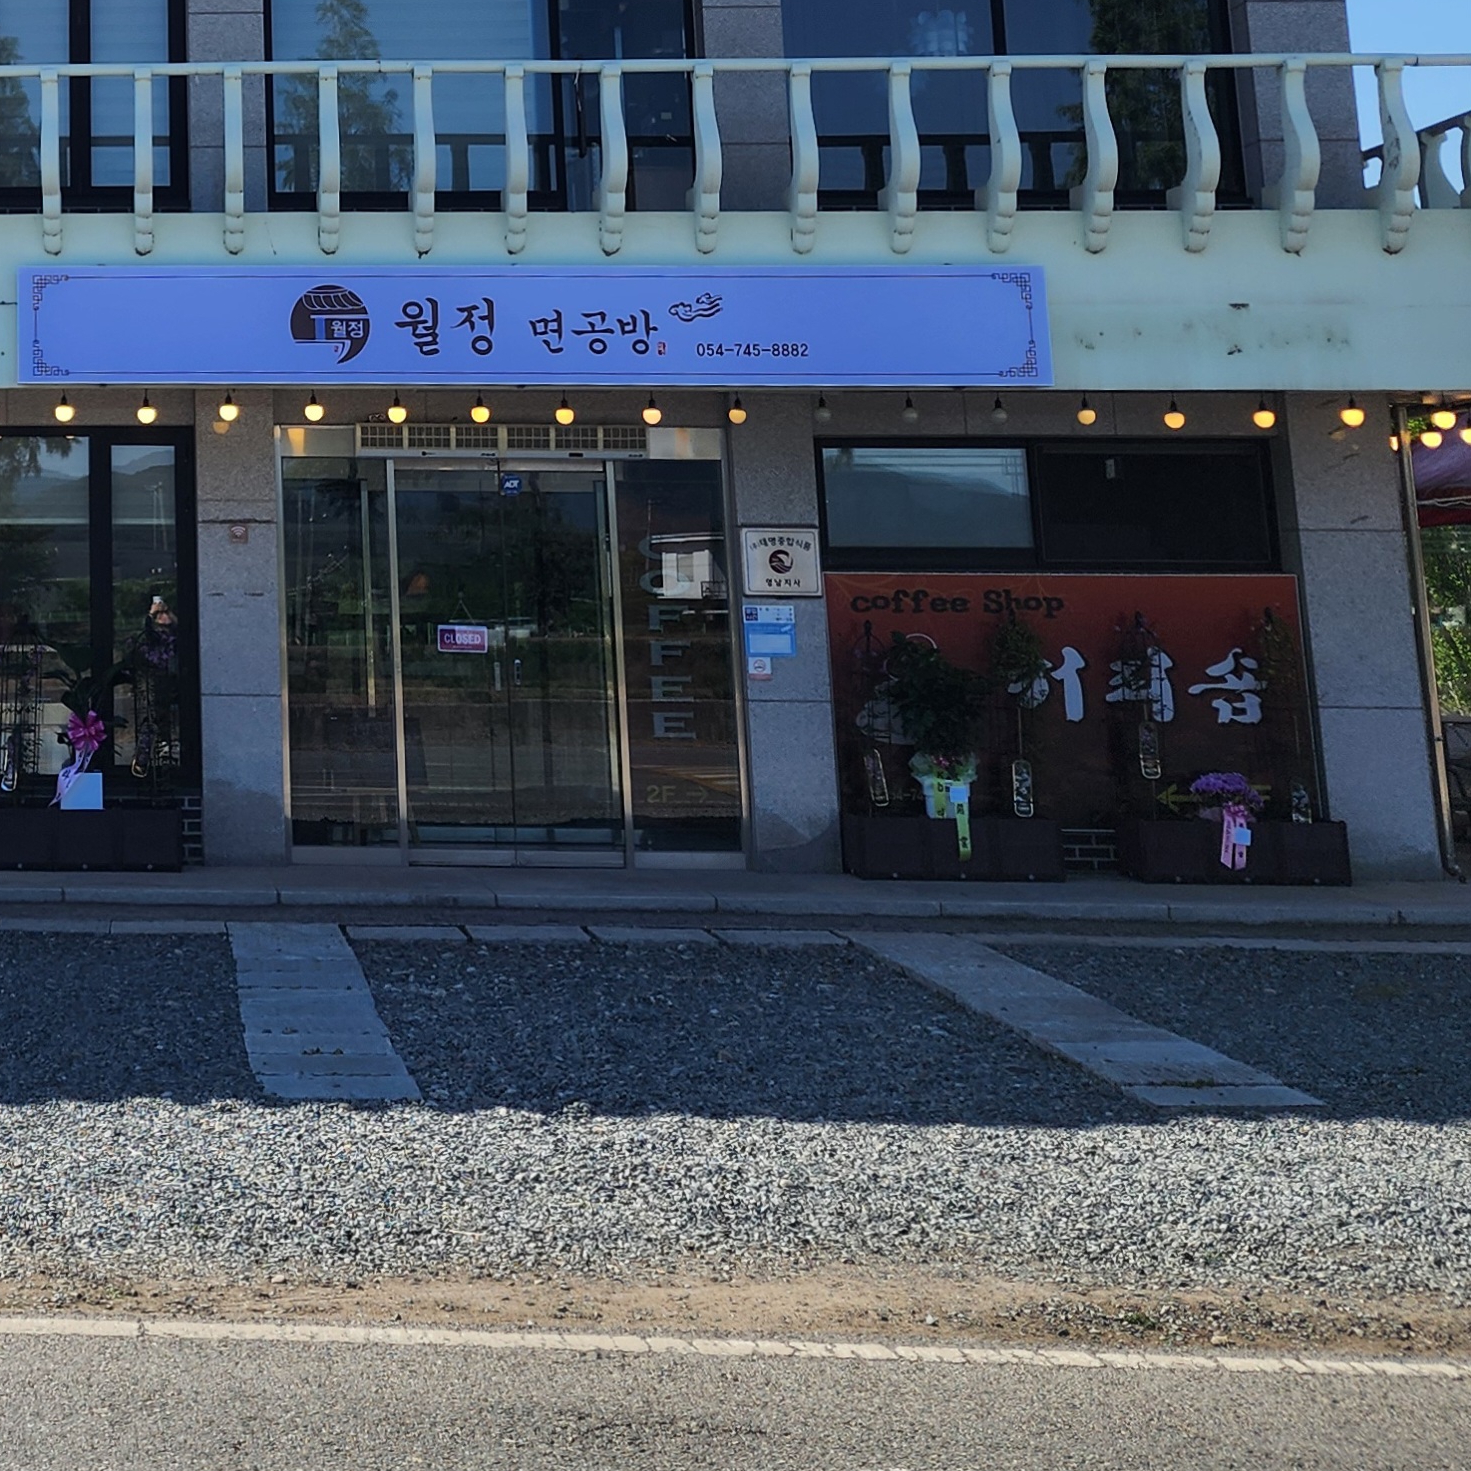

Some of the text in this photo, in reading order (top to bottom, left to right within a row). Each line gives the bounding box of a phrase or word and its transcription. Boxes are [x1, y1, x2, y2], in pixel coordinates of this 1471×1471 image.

[331, 320, 364, 338] 월정
[394, 297, 659, 357] 월정 면공방
[696, 342, 809, 358] 054-745-8882
[503, 479, 520, 489] ADT
[850, 588, 1064, 619] coffee Shop
[444, 633, 482, 645] CLOSED
[646, 785, 677, 803] 2F
